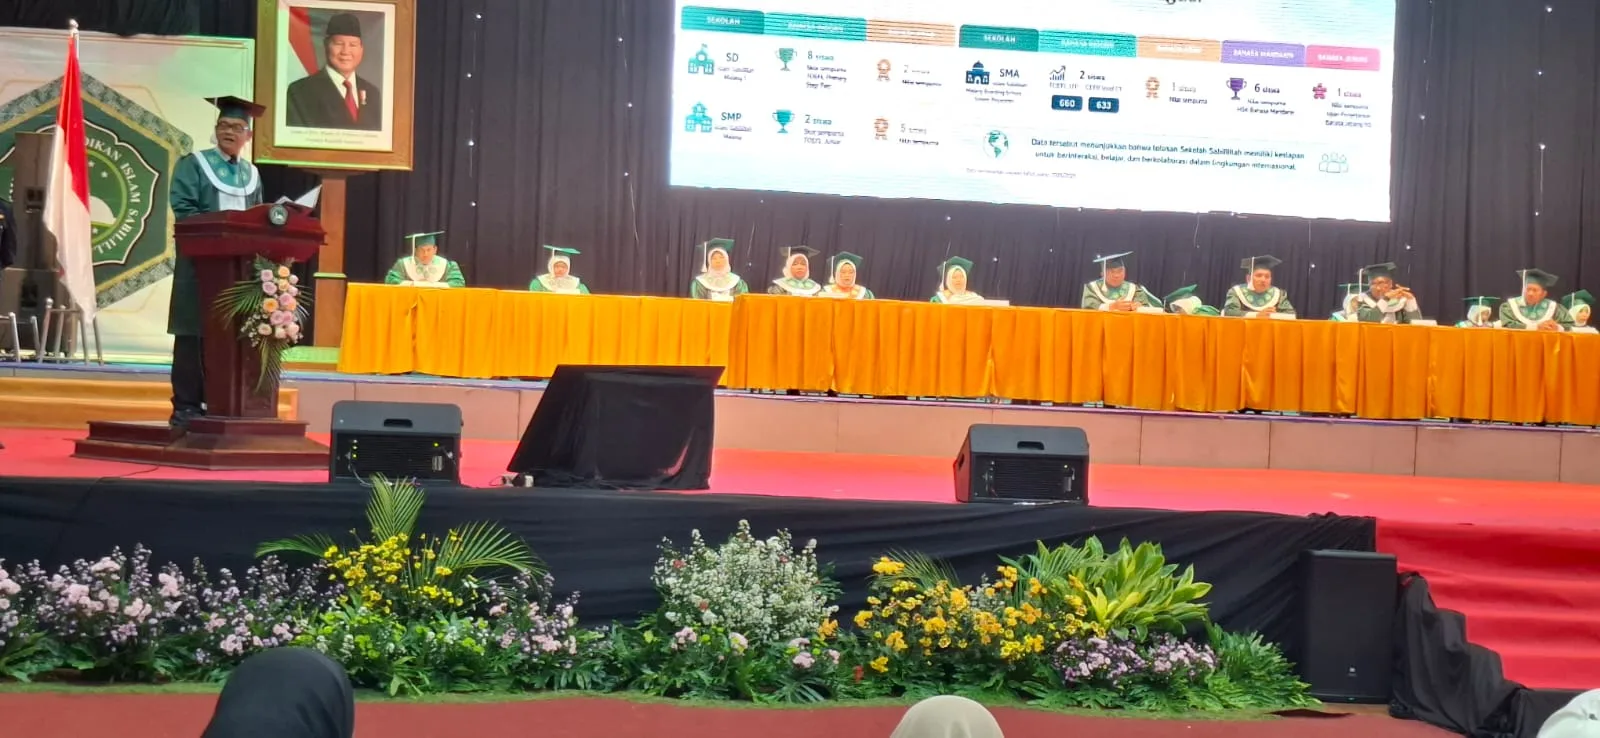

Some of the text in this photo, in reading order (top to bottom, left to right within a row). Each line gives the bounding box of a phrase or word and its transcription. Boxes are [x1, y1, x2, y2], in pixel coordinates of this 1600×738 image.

[706, 16, 740, 26] SEKOLAH
[984, 34, 1016, 43] SEKOLAH
[726, 52, 739, 62] SD
[808, 50, 812, 60] 8
[999, 68, 1020, 78] SMA
[1080, 70, 1085, 80] 2
[1254, 84, 1261, 93] 6
[1059, 99, 1076, 108] 660
[1096, 101, 1112, 110] 633
[720, 112, 742, 120] SMP
[804, 114, 810, 124] 2
[1031, 138, 1048, 146] Data
[1080, 142, 1127, 151] menunjukkan
[1180, 146, 1207, 154] Sekolah
[1189, 158, 1210, 166] dalam
[1212, 160, 1250, 169] lingkungan
[120, 162, 141, 203] ISLAM
